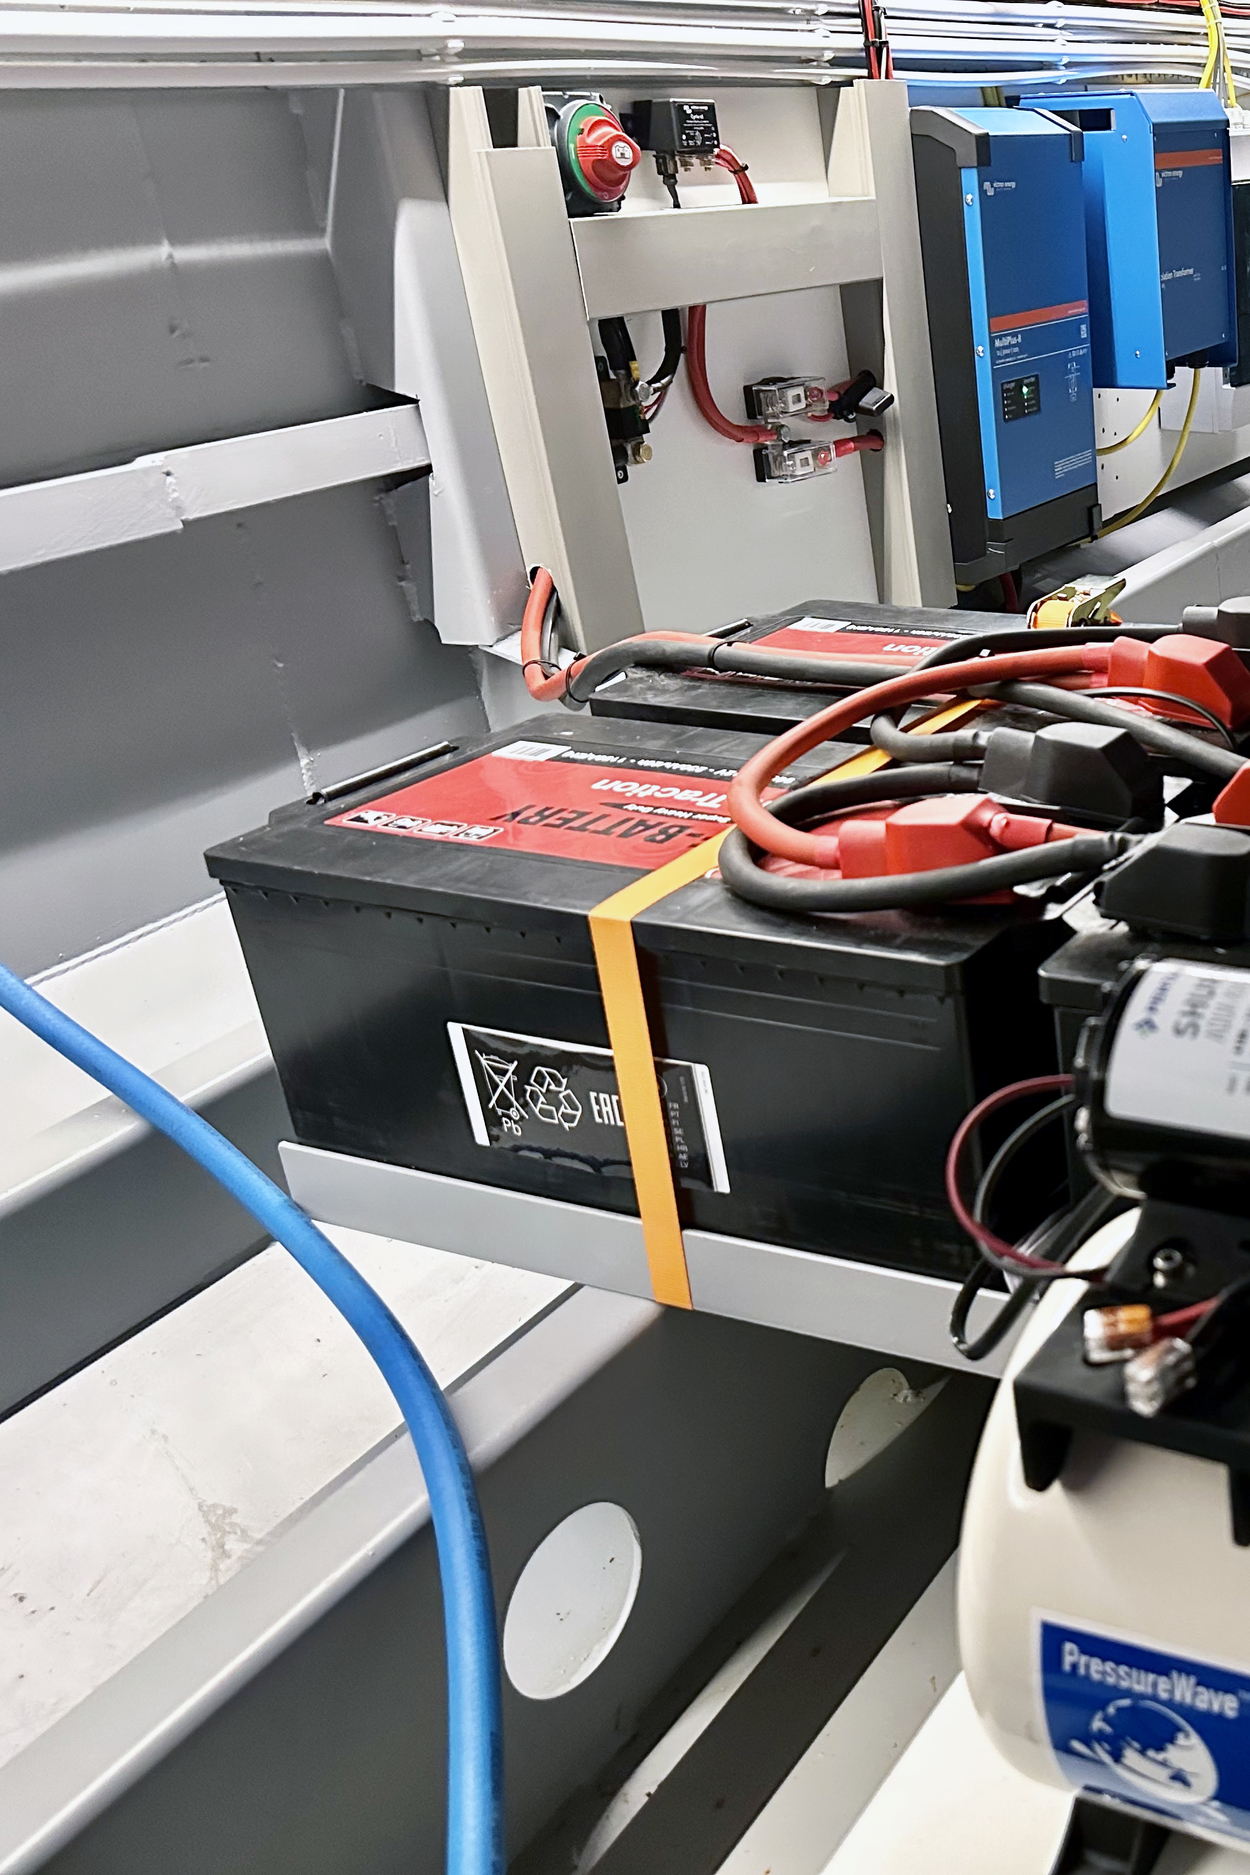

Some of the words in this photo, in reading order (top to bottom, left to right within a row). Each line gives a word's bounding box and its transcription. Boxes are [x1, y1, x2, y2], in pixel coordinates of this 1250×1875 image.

[591, 778, 728, 808] Traction
[622, 803, 654, 814] Duty
[657, 807, 694, 818] Heavy
[493, 803, 710, 847] -BATTERY
[502, 1120, 522, 1136] Pb
[674, 1127, 684, 1135] SE
[1061, 1641, 1240, 1720] PressureWave
